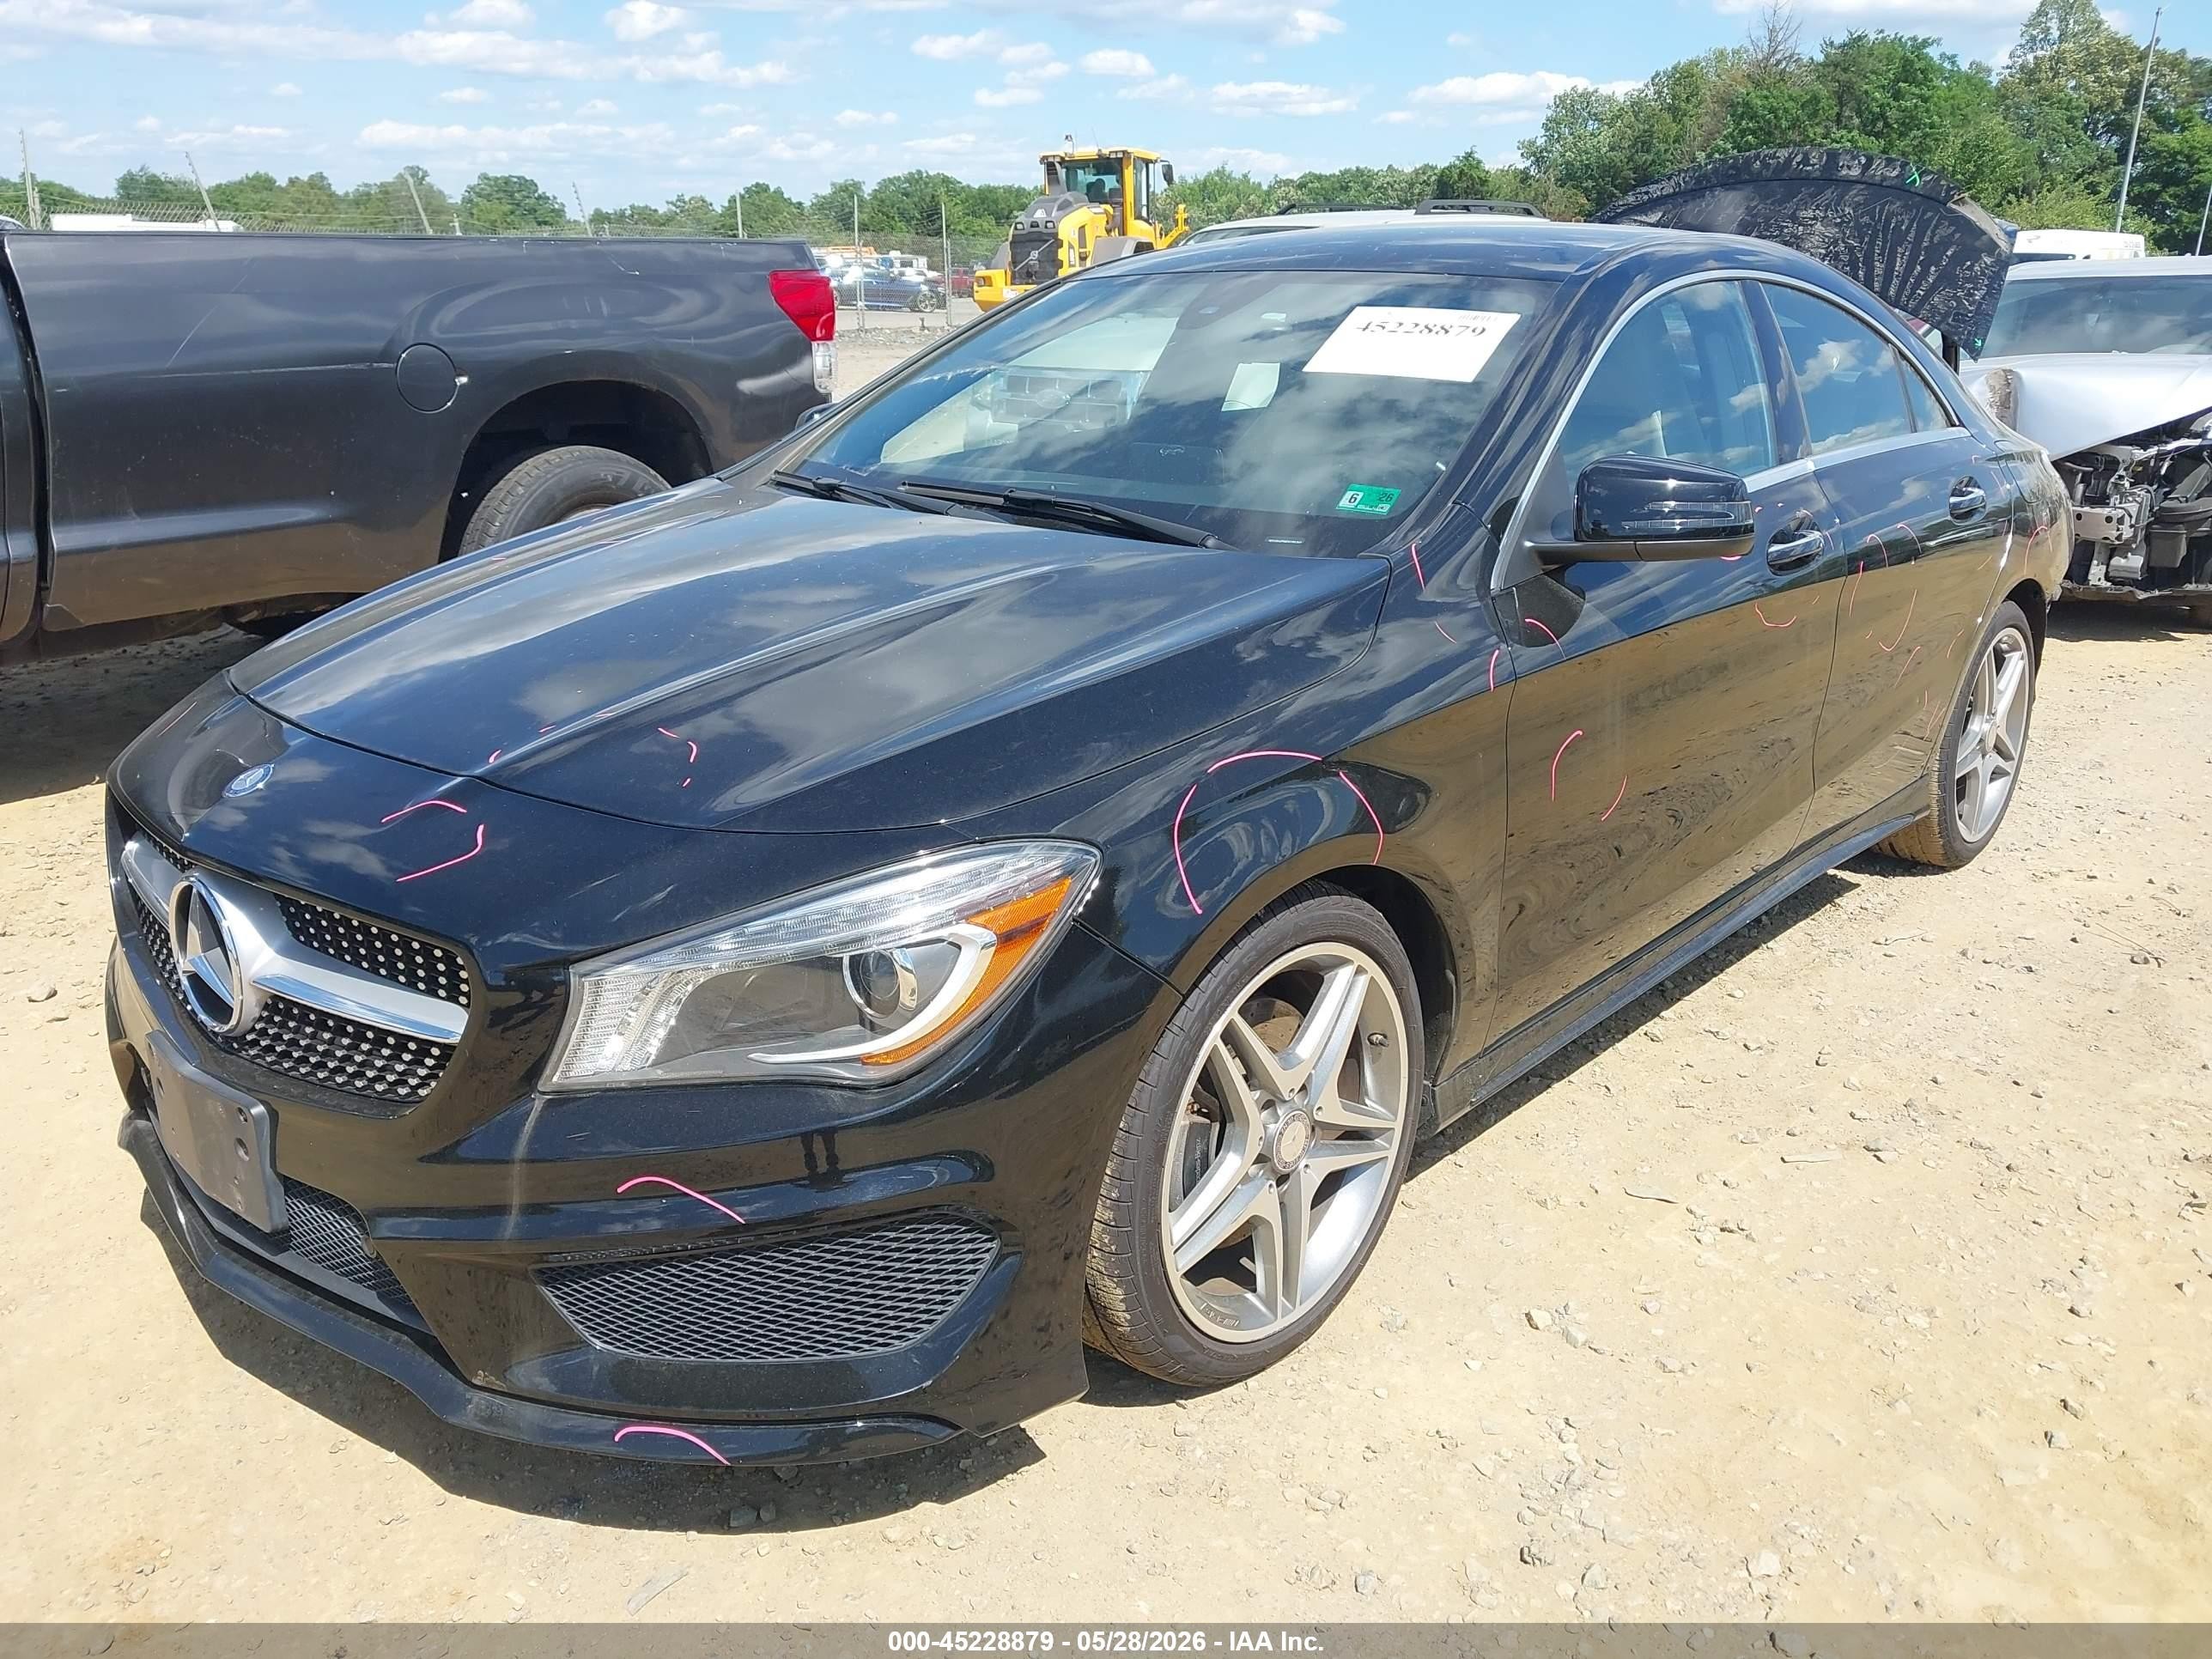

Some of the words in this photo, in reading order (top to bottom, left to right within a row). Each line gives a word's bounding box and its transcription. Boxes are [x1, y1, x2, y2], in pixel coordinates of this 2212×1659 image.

[1357, 321, 1486, 337] 45228879
[1348, 493, 1359, 504] 6
[1378, 492, 1395, 502] 26
